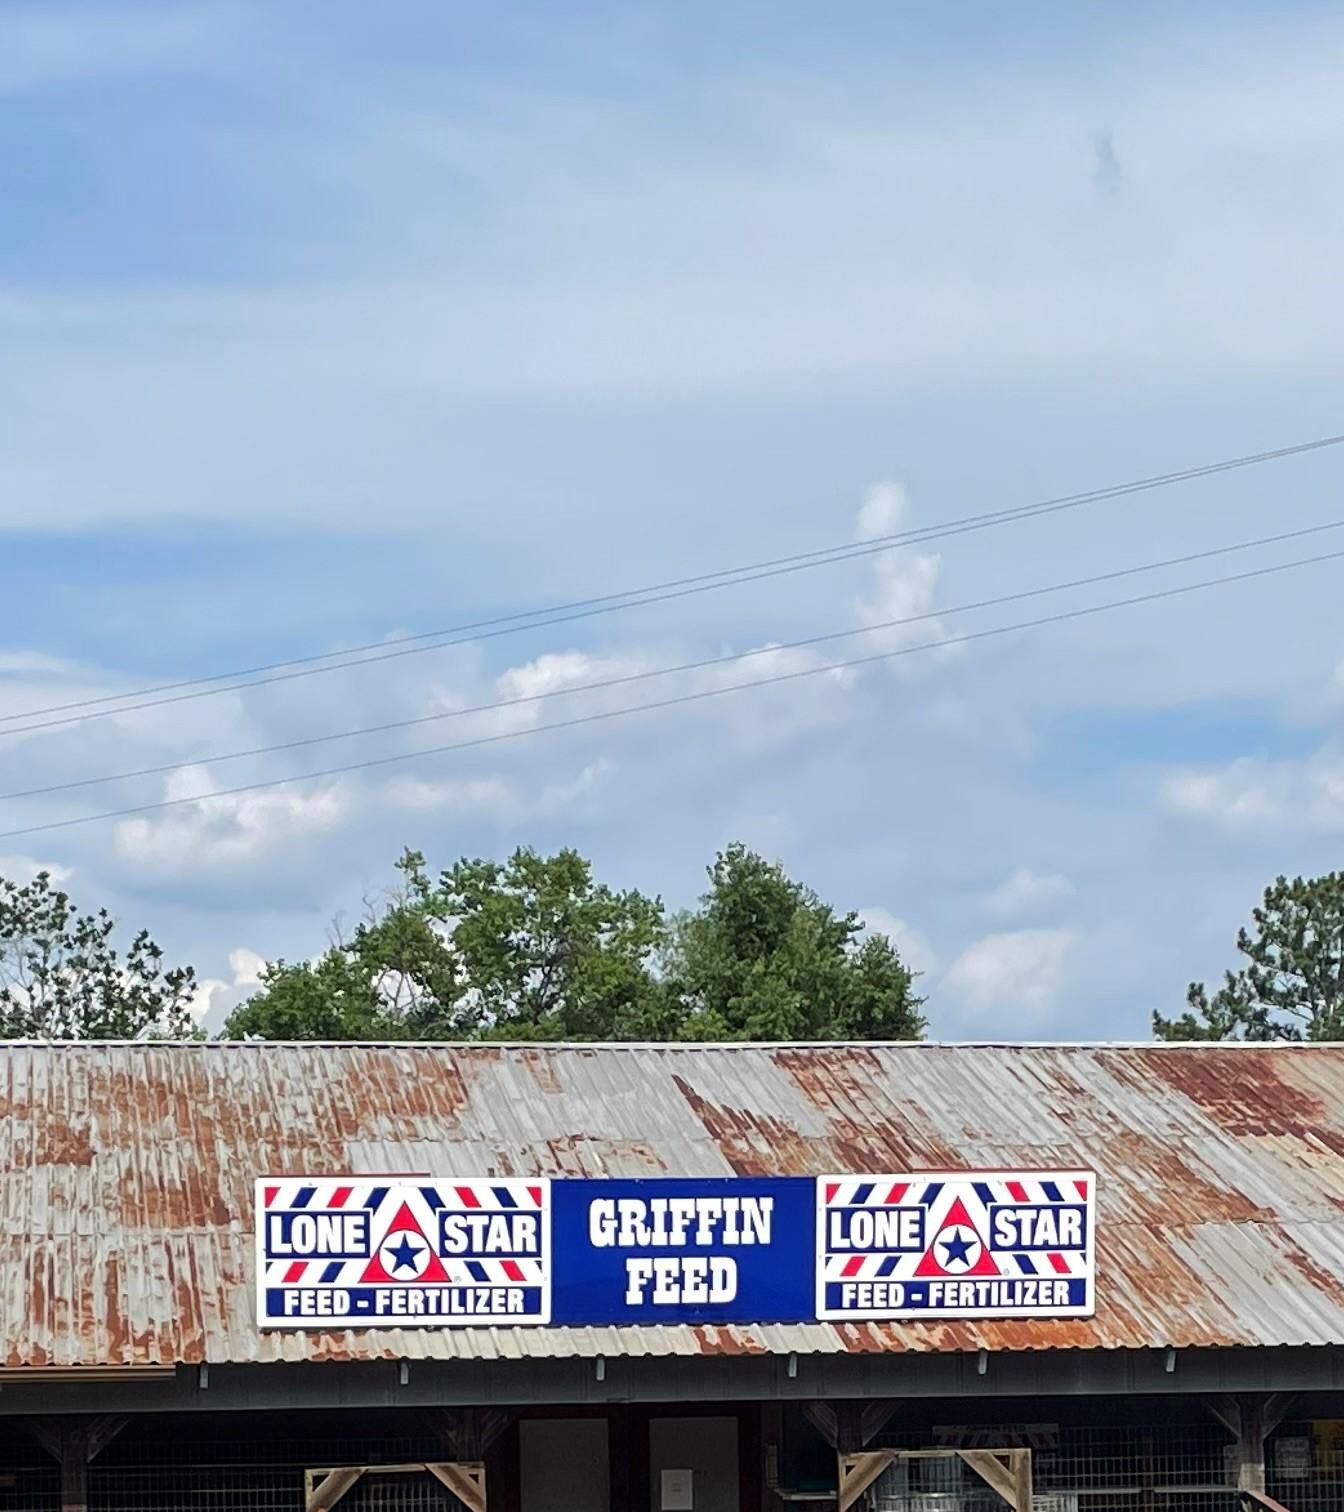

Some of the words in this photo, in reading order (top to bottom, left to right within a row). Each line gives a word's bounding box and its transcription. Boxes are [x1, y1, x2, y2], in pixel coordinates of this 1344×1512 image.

[269, 1214, 366, 1255] LONE
[443, 1214, 538, 1255] STAR
[589, 1197, 774, 1248] GRIFFIN
[829, 1209, 921, 1250] LONE
[993, 1208, 1083, 1248] STAR
[625, 1256, 738, 1305] FEED
[841, 1282, 905, 1309] FEED
[928, 1279, 1070, 1308] FERTILIZER
[283, 1289, 351, 1316] FEED
[375, 1287, 525, 1315] FERTILIZER
